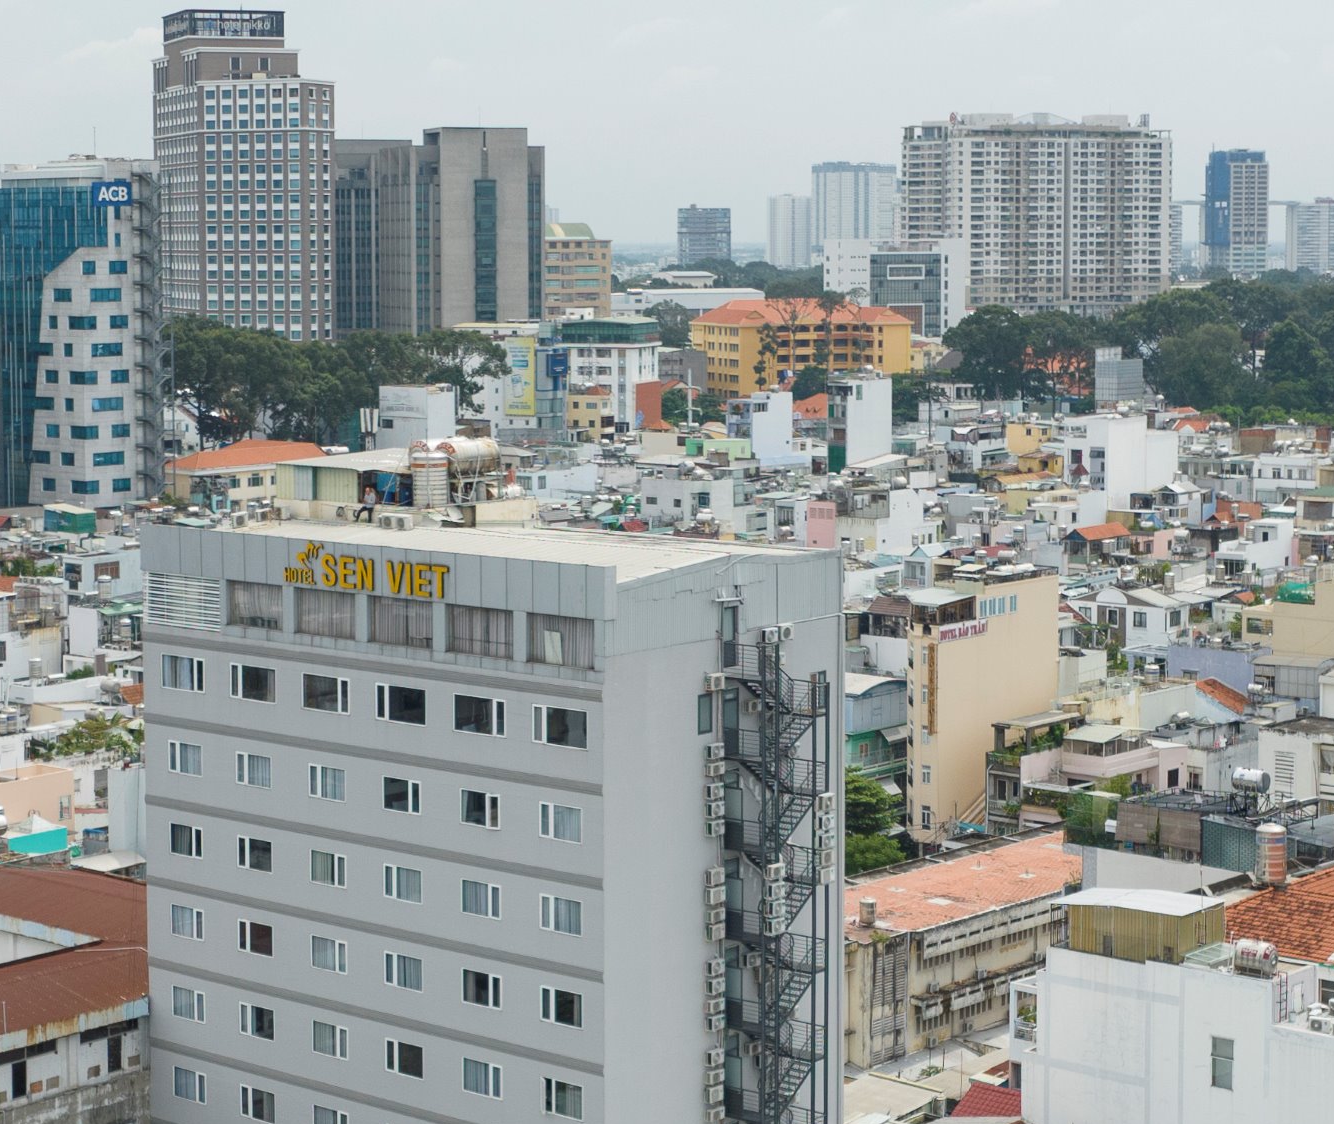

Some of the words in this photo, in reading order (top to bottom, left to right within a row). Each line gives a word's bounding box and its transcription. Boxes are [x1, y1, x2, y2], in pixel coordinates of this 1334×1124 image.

[217, 19, 242, 30] hotel
[243, 18, 271, 31] nikko
[98, 186, 128, 201] ACB
[283, 567, 316, 585] HOTEL
[321, 552, 374, 591] SEN
[386, 549, 450, 599] VIET
